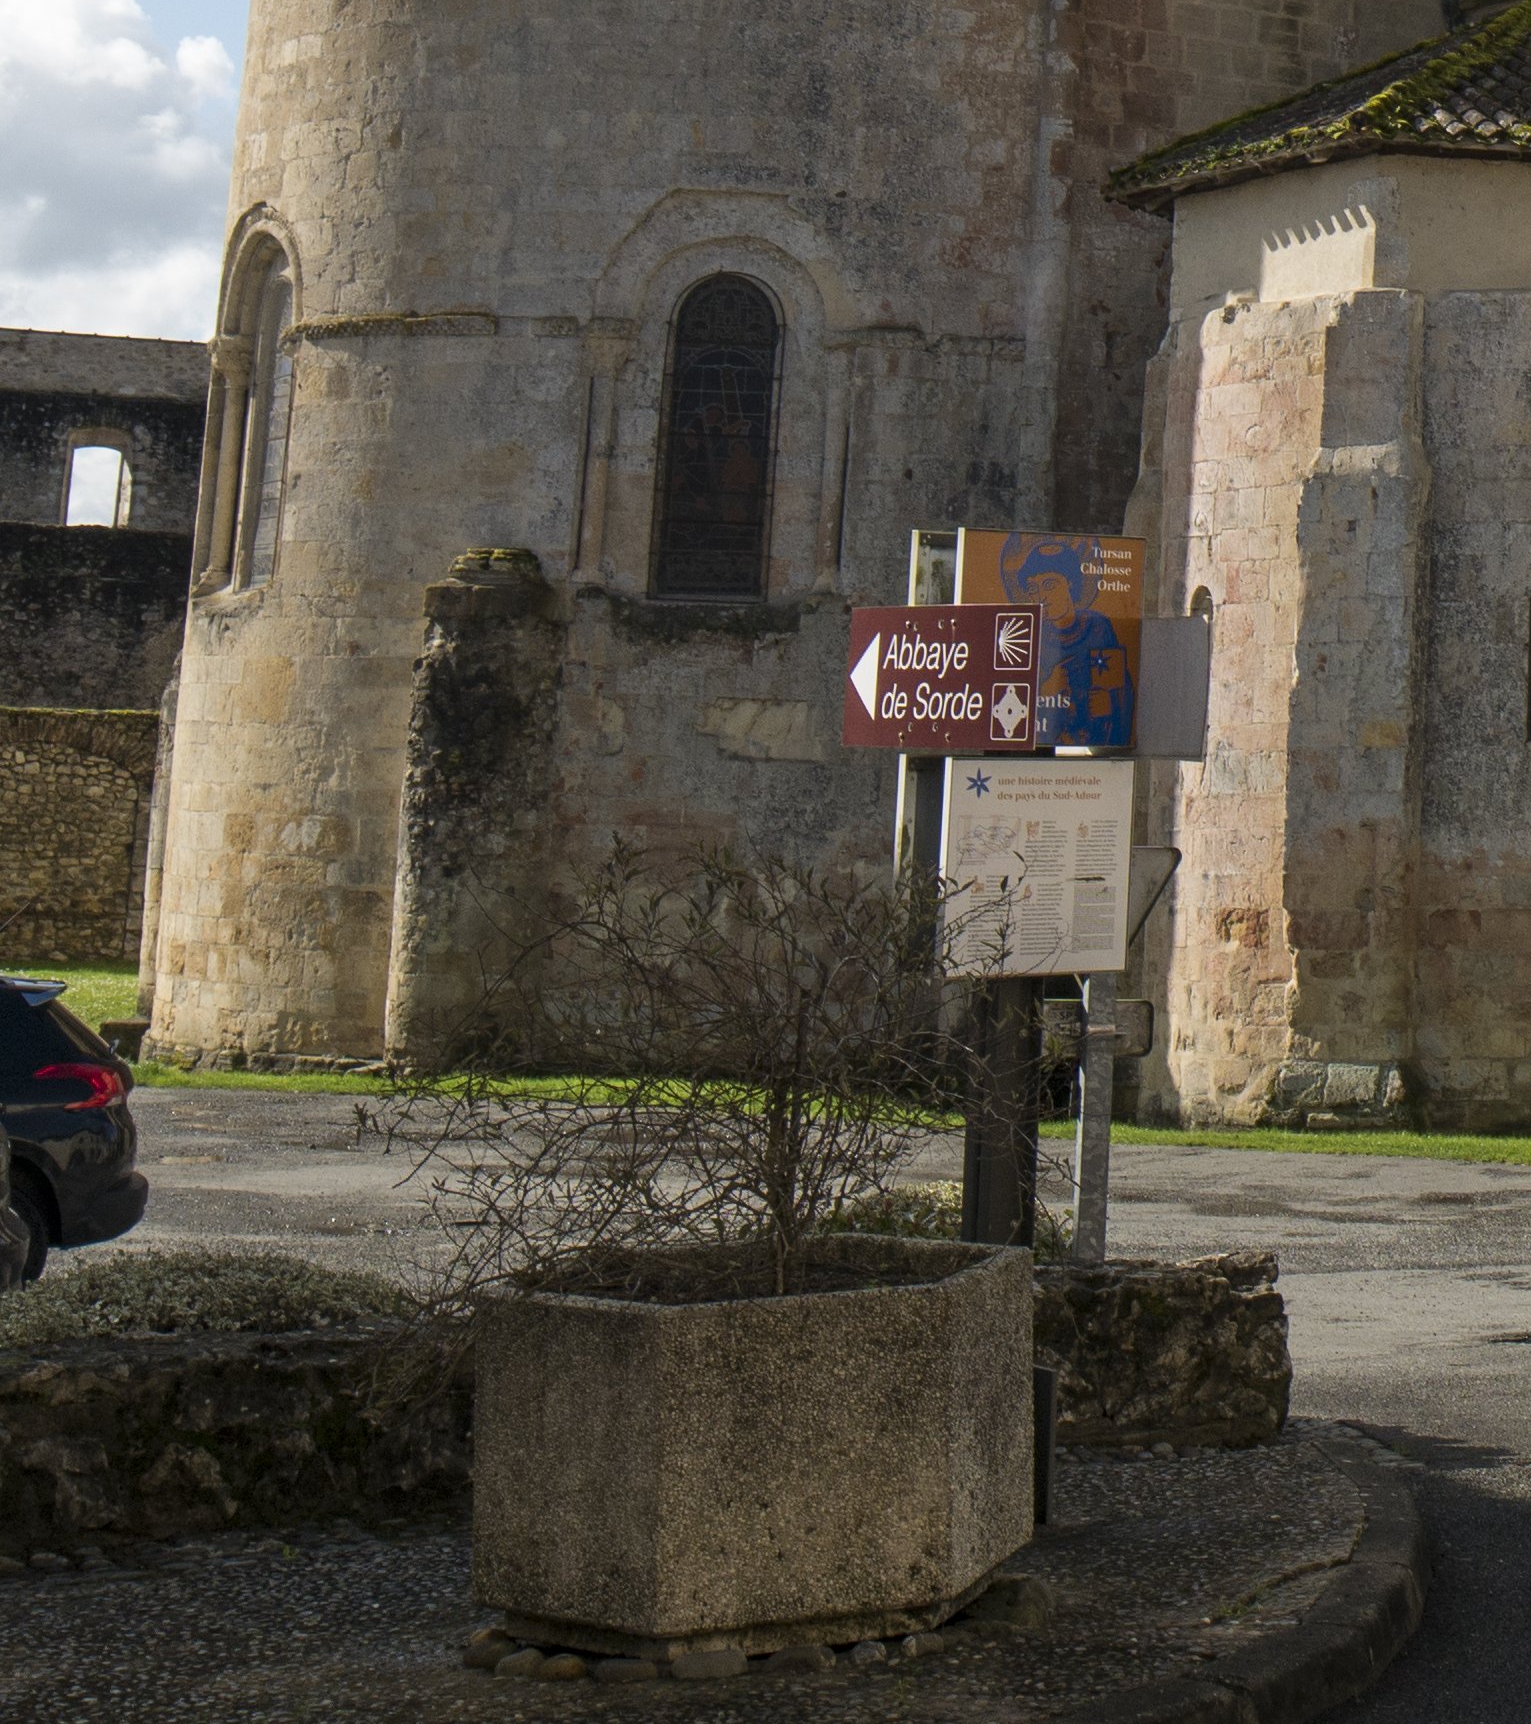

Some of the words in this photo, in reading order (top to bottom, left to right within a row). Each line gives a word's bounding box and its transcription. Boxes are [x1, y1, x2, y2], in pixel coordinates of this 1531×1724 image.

[1092, 547, 1132, 559] Tursan
[1080, 562, 1132, 575] Chalosse
[1097, 579, 1131, 592] Orthe
[882, 633, 969, 679] Abbaye
[881, 683, 908, 719] de
[912, 682, 983, 721] Sorde
[1036, 693, 1071, 708] ents
[997, 776, 1015, 786] une
[1018, 775, 1053, 786] histoire
[1055, 775, 1102, 786] médiévale
[997, 791, 1014, 801] des
[1015, 791, 1036, 803] pays
[1038, 791, 1051, 801] du
[1052, 791, 1102, 801] Sud-Adour
